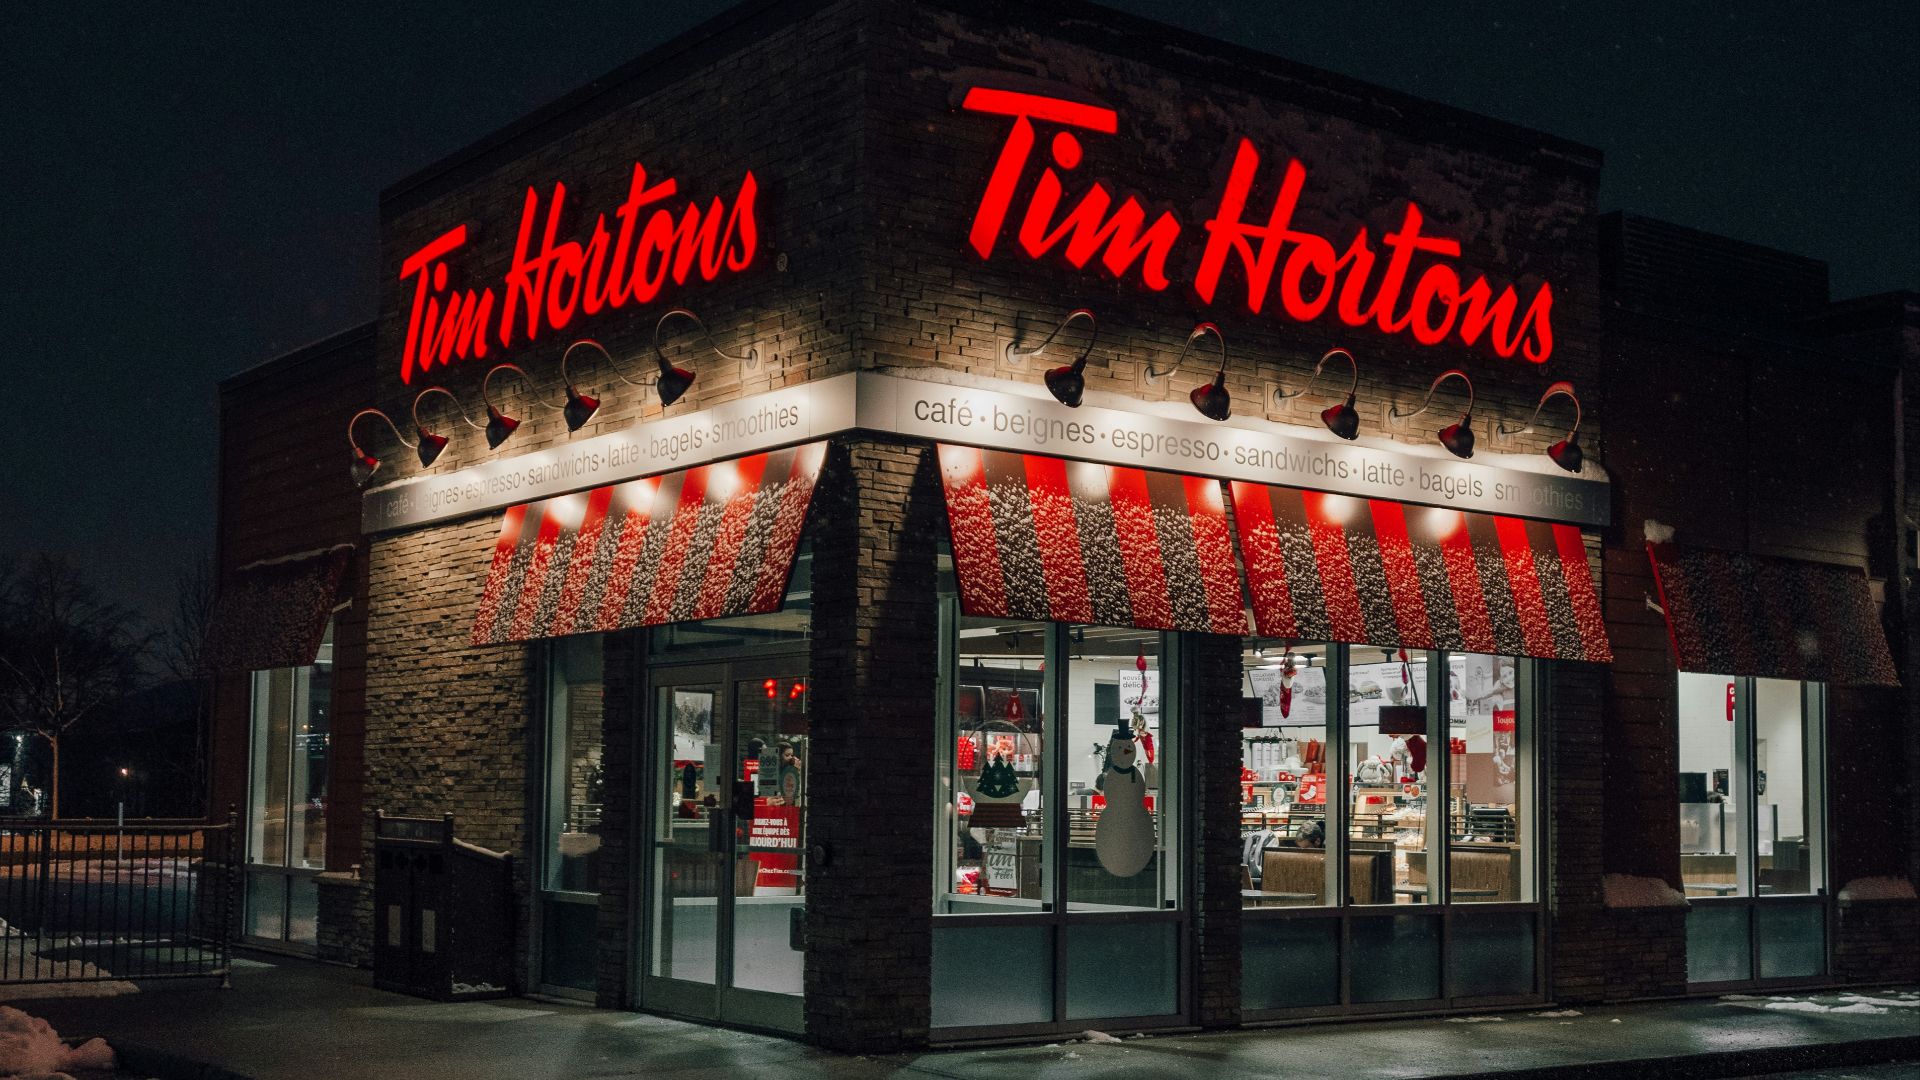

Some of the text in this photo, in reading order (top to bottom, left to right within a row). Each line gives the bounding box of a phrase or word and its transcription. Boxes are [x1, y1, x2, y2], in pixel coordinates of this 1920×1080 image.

[400, 163, 757, 380] Tim Hortons
[963, 87, 1552, 363] Tim Hortons
[386, 402, 800, 519] café eignes espresso sandwichs latte bagels smoothies
[914, 397, 1585, 511] café beignes espresso sandwichs latte bagels smothies
